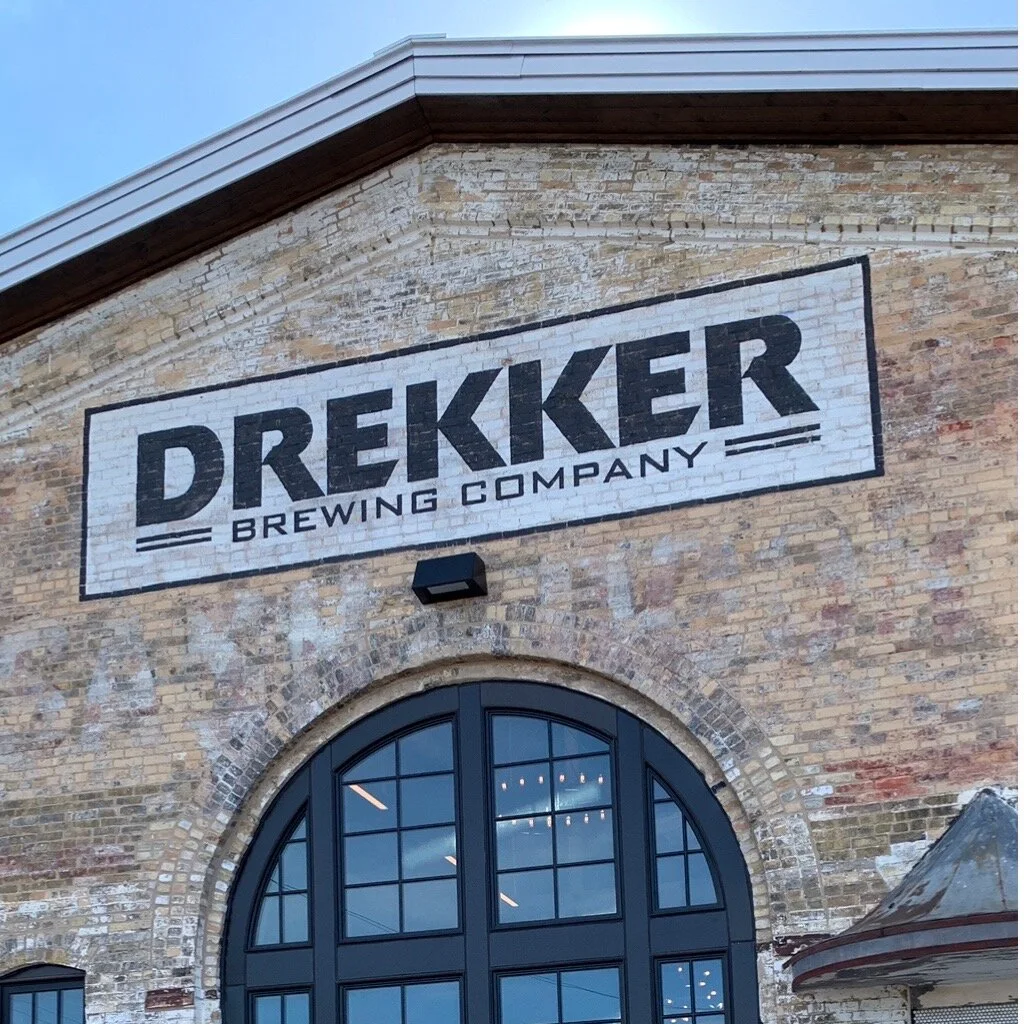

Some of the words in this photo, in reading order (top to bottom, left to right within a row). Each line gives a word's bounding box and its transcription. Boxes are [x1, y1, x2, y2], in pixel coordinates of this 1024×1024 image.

[136, 314, 821, 527] DREKKER
[232, 487, 437, 542] BREWING
[461, 441, 708, 506] COMPANY
